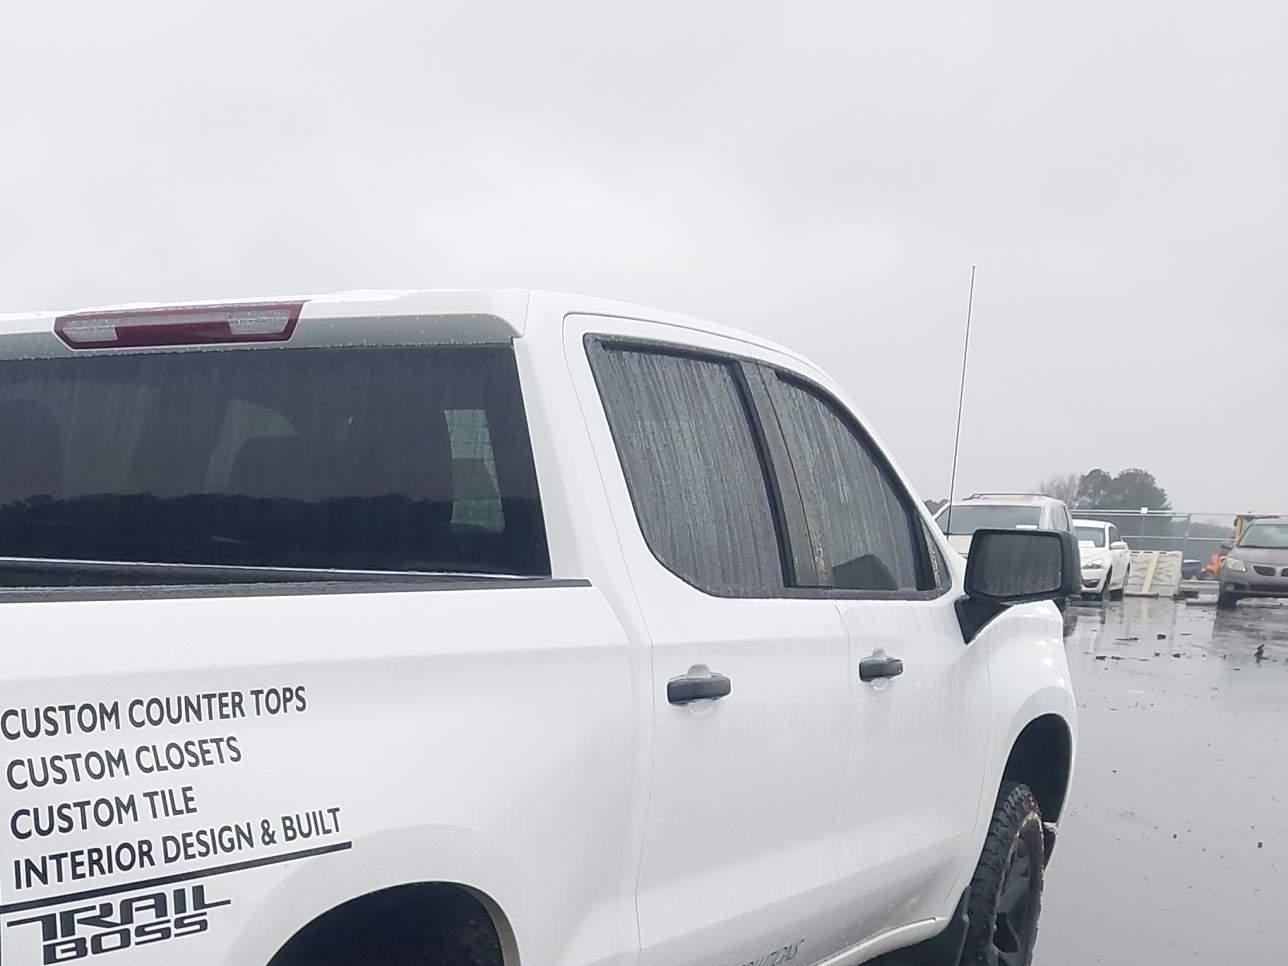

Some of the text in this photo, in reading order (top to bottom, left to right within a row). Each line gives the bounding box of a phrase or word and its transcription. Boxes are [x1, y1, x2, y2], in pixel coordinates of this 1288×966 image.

[1, 685, 307, 741] CUSTOM COUNTER TOPS
[6, 735, 242, 791] CUSTOM CLOSETS
[10, 785, 198, 840] CUSTOM TILE
[13, 807, 342, 890] INTERIOR DESIGN & BUILT
[7, 884, 232, 942] TRAIL
[43, 911, 209, 965] BOSS
